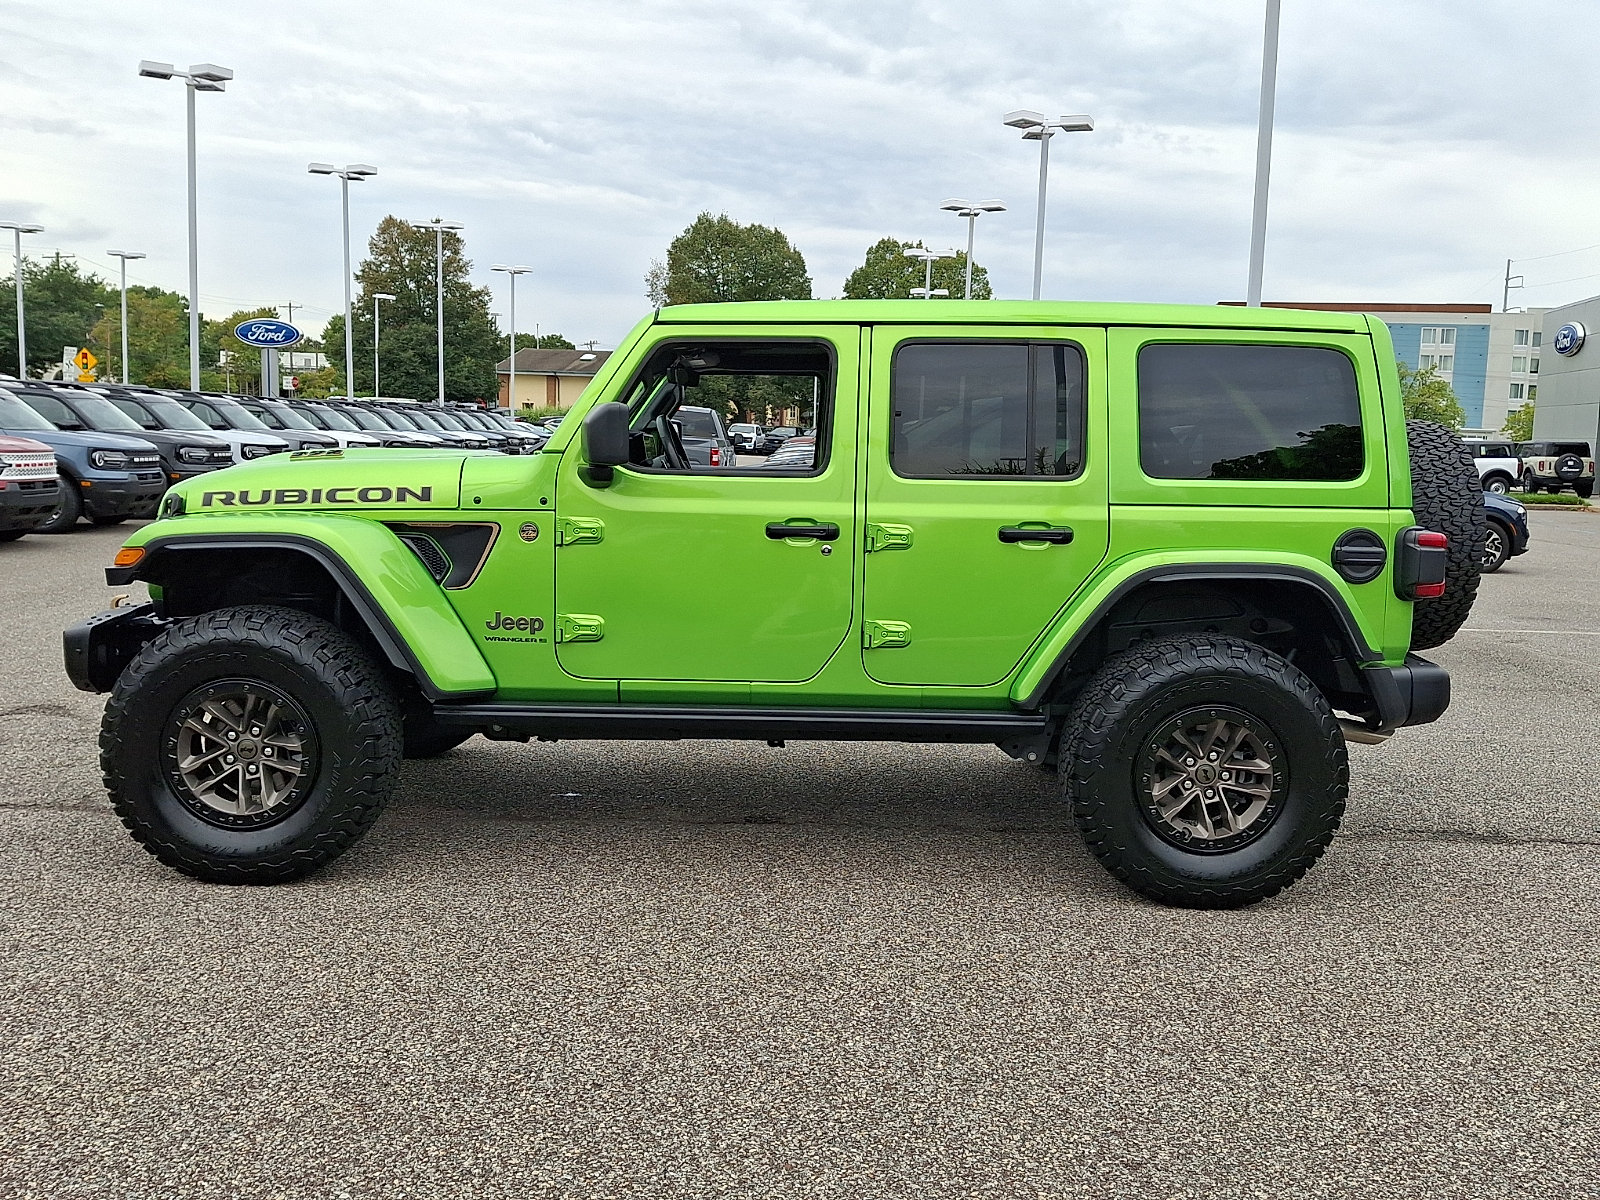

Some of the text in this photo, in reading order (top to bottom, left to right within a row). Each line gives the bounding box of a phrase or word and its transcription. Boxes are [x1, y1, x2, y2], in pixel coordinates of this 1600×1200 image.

[247, 323, 287, 341] Ford
[1556, 329, 1573, 349] Ford
[201, 486, 432, 507] RUBICON
[485, 611, 544, 635] Jeep
[484, 635, 537, 643] WRANGLER
